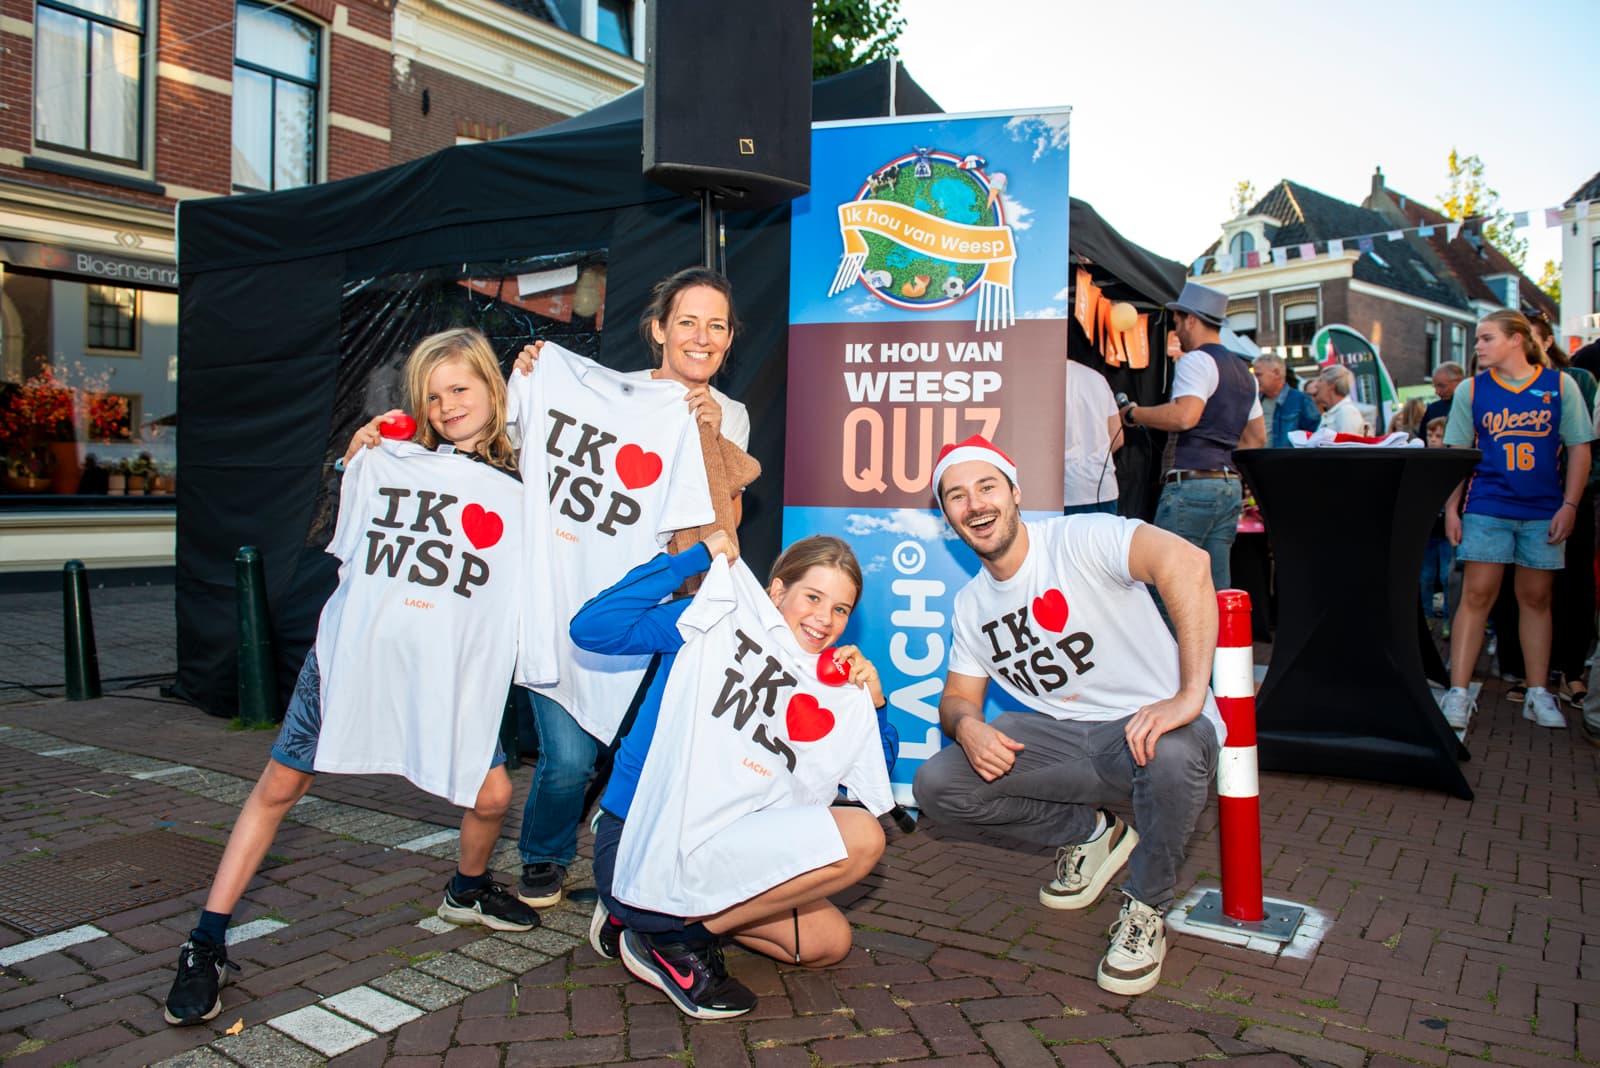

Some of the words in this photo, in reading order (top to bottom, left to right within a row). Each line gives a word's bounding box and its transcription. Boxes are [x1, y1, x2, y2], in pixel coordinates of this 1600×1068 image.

[846, 208, 862, 223] Ik
[866, 208, 901, 231] hou
[903, 223, 936, 246] van
[941, 235, 1004, 257] Weesp
[845, 343, 873, 363] IK
[880, 342, 939, 363] HOU
[945, 341, 1002, 363] VAN
[843, 371, 1002, 403] WEESP
[546, 408, 618, 476] IK
[1482, 407, 1552, 436] Weesp
[1503, 442, 1535, 471] 16
[371, 487, 458, 536] IK
[364, 530, 490, 599] WSP
[981, 606, 1040, 663] IK
[998, 631, 1095, 697] WSP
